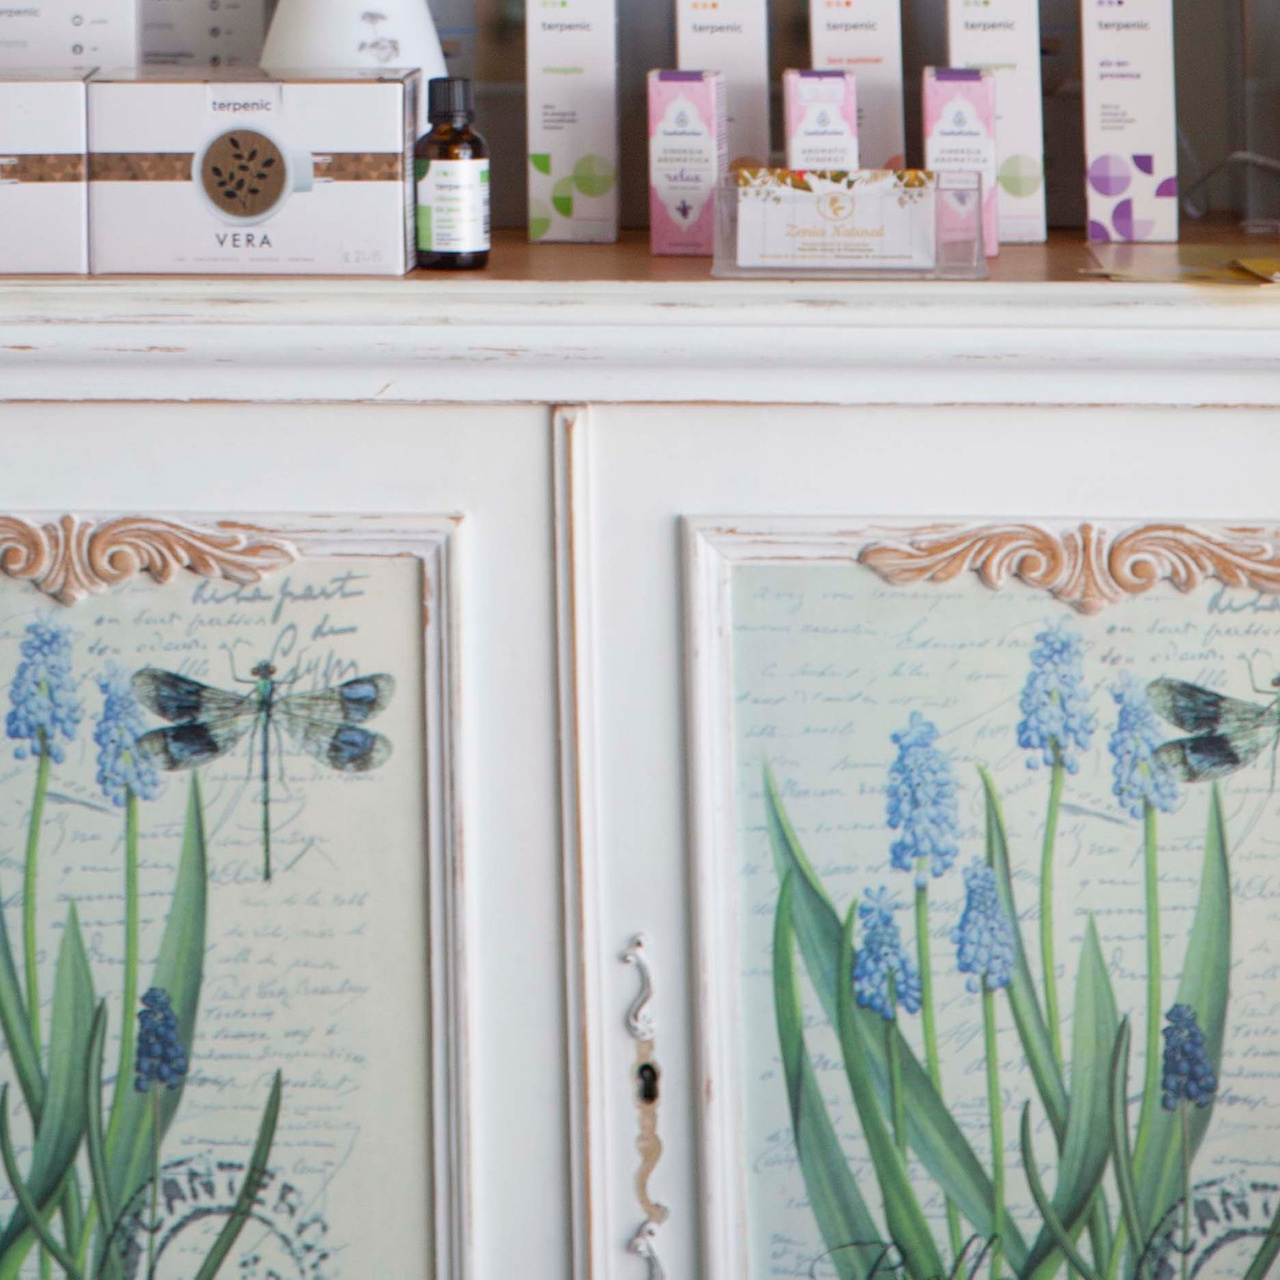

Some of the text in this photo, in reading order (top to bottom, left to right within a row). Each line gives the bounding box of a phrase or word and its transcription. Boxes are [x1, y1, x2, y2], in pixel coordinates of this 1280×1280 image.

[542, 20, 593, 35] terpenic
[691, 21, 743, 36] terpenic
[825, 19, 878, 34] terpenic
[963, 18, 1017, 33] terpenic
[1097, 17, 1150, 32] terpenic
[212, 98, 272, 114] terpenic
[215, 232, 274, 249] VERA
